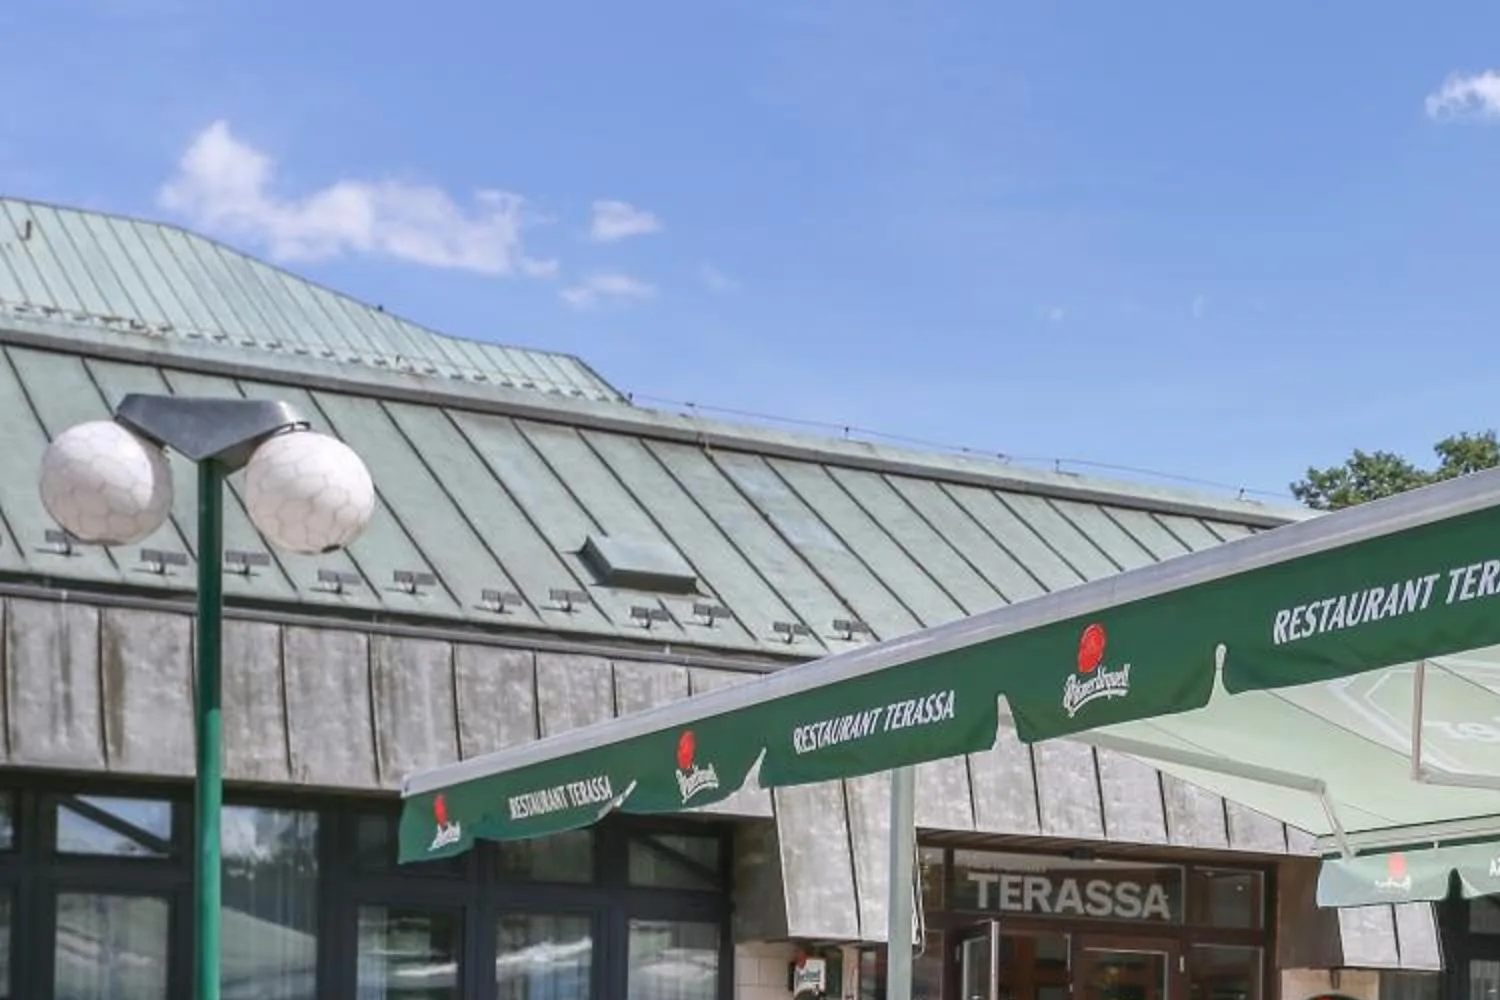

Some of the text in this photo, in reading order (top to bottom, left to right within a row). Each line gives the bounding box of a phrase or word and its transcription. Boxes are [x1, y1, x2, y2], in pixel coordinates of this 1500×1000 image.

[1272, 574, 1439, 644] RESTAURANT
[793, 690, 955, 754] RESTAURANT TERASSA
[509, 775, 613, 819] RESTAURANT TERASSA
[968, 871, 1171, 920] TERASSA
